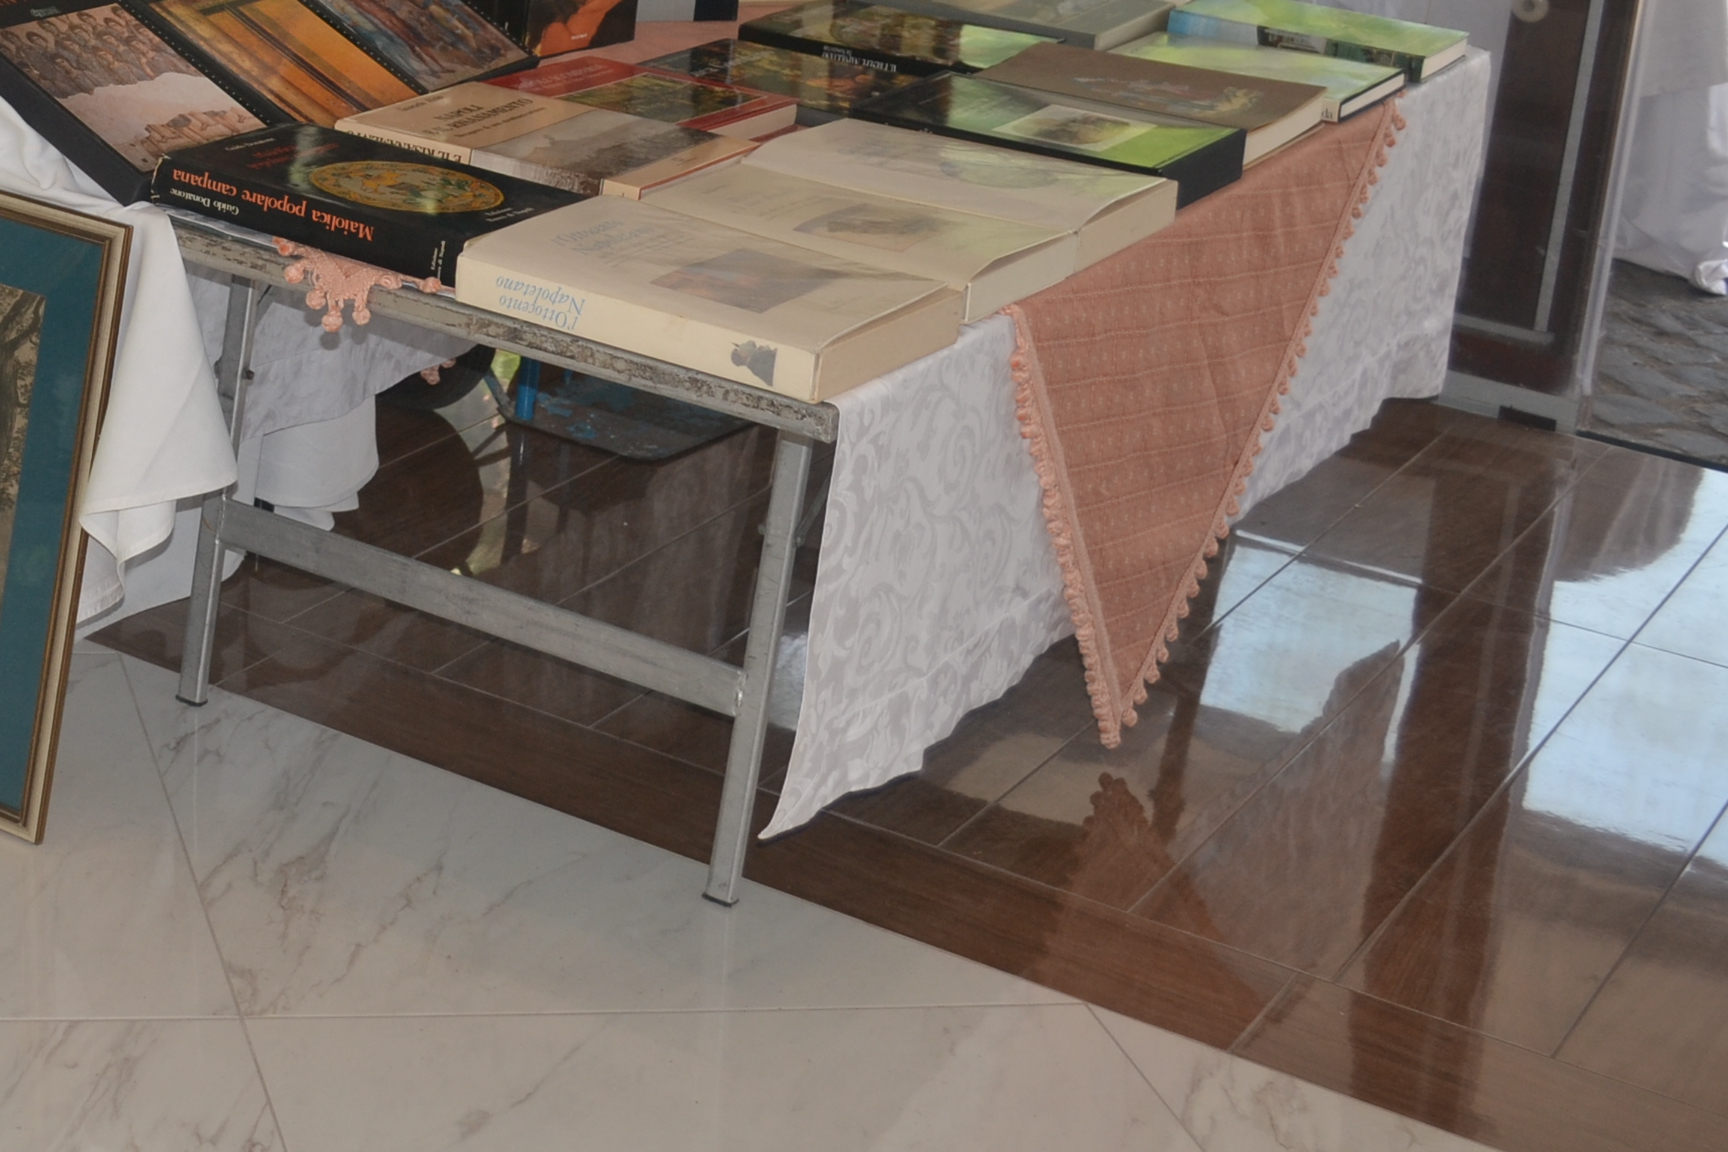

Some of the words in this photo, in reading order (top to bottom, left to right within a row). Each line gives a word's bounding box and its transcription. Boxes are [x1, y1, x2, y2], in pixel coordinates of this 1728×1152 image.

[433, 104, 484, 122] NAPOLI
[449, 98, 533, 129] RISANAMENTO
[172, 168, 237, 197] campana
[169, 187, 211, 208] Donatone
[213, 200, 240, 216] Guido
[241, 189, 308, 217] popolare
[311, 209, 375, 242] Maiolica
[495, 275, 587, 316] Napoletano
[498, 294, 579, 331] l'Ottocento
